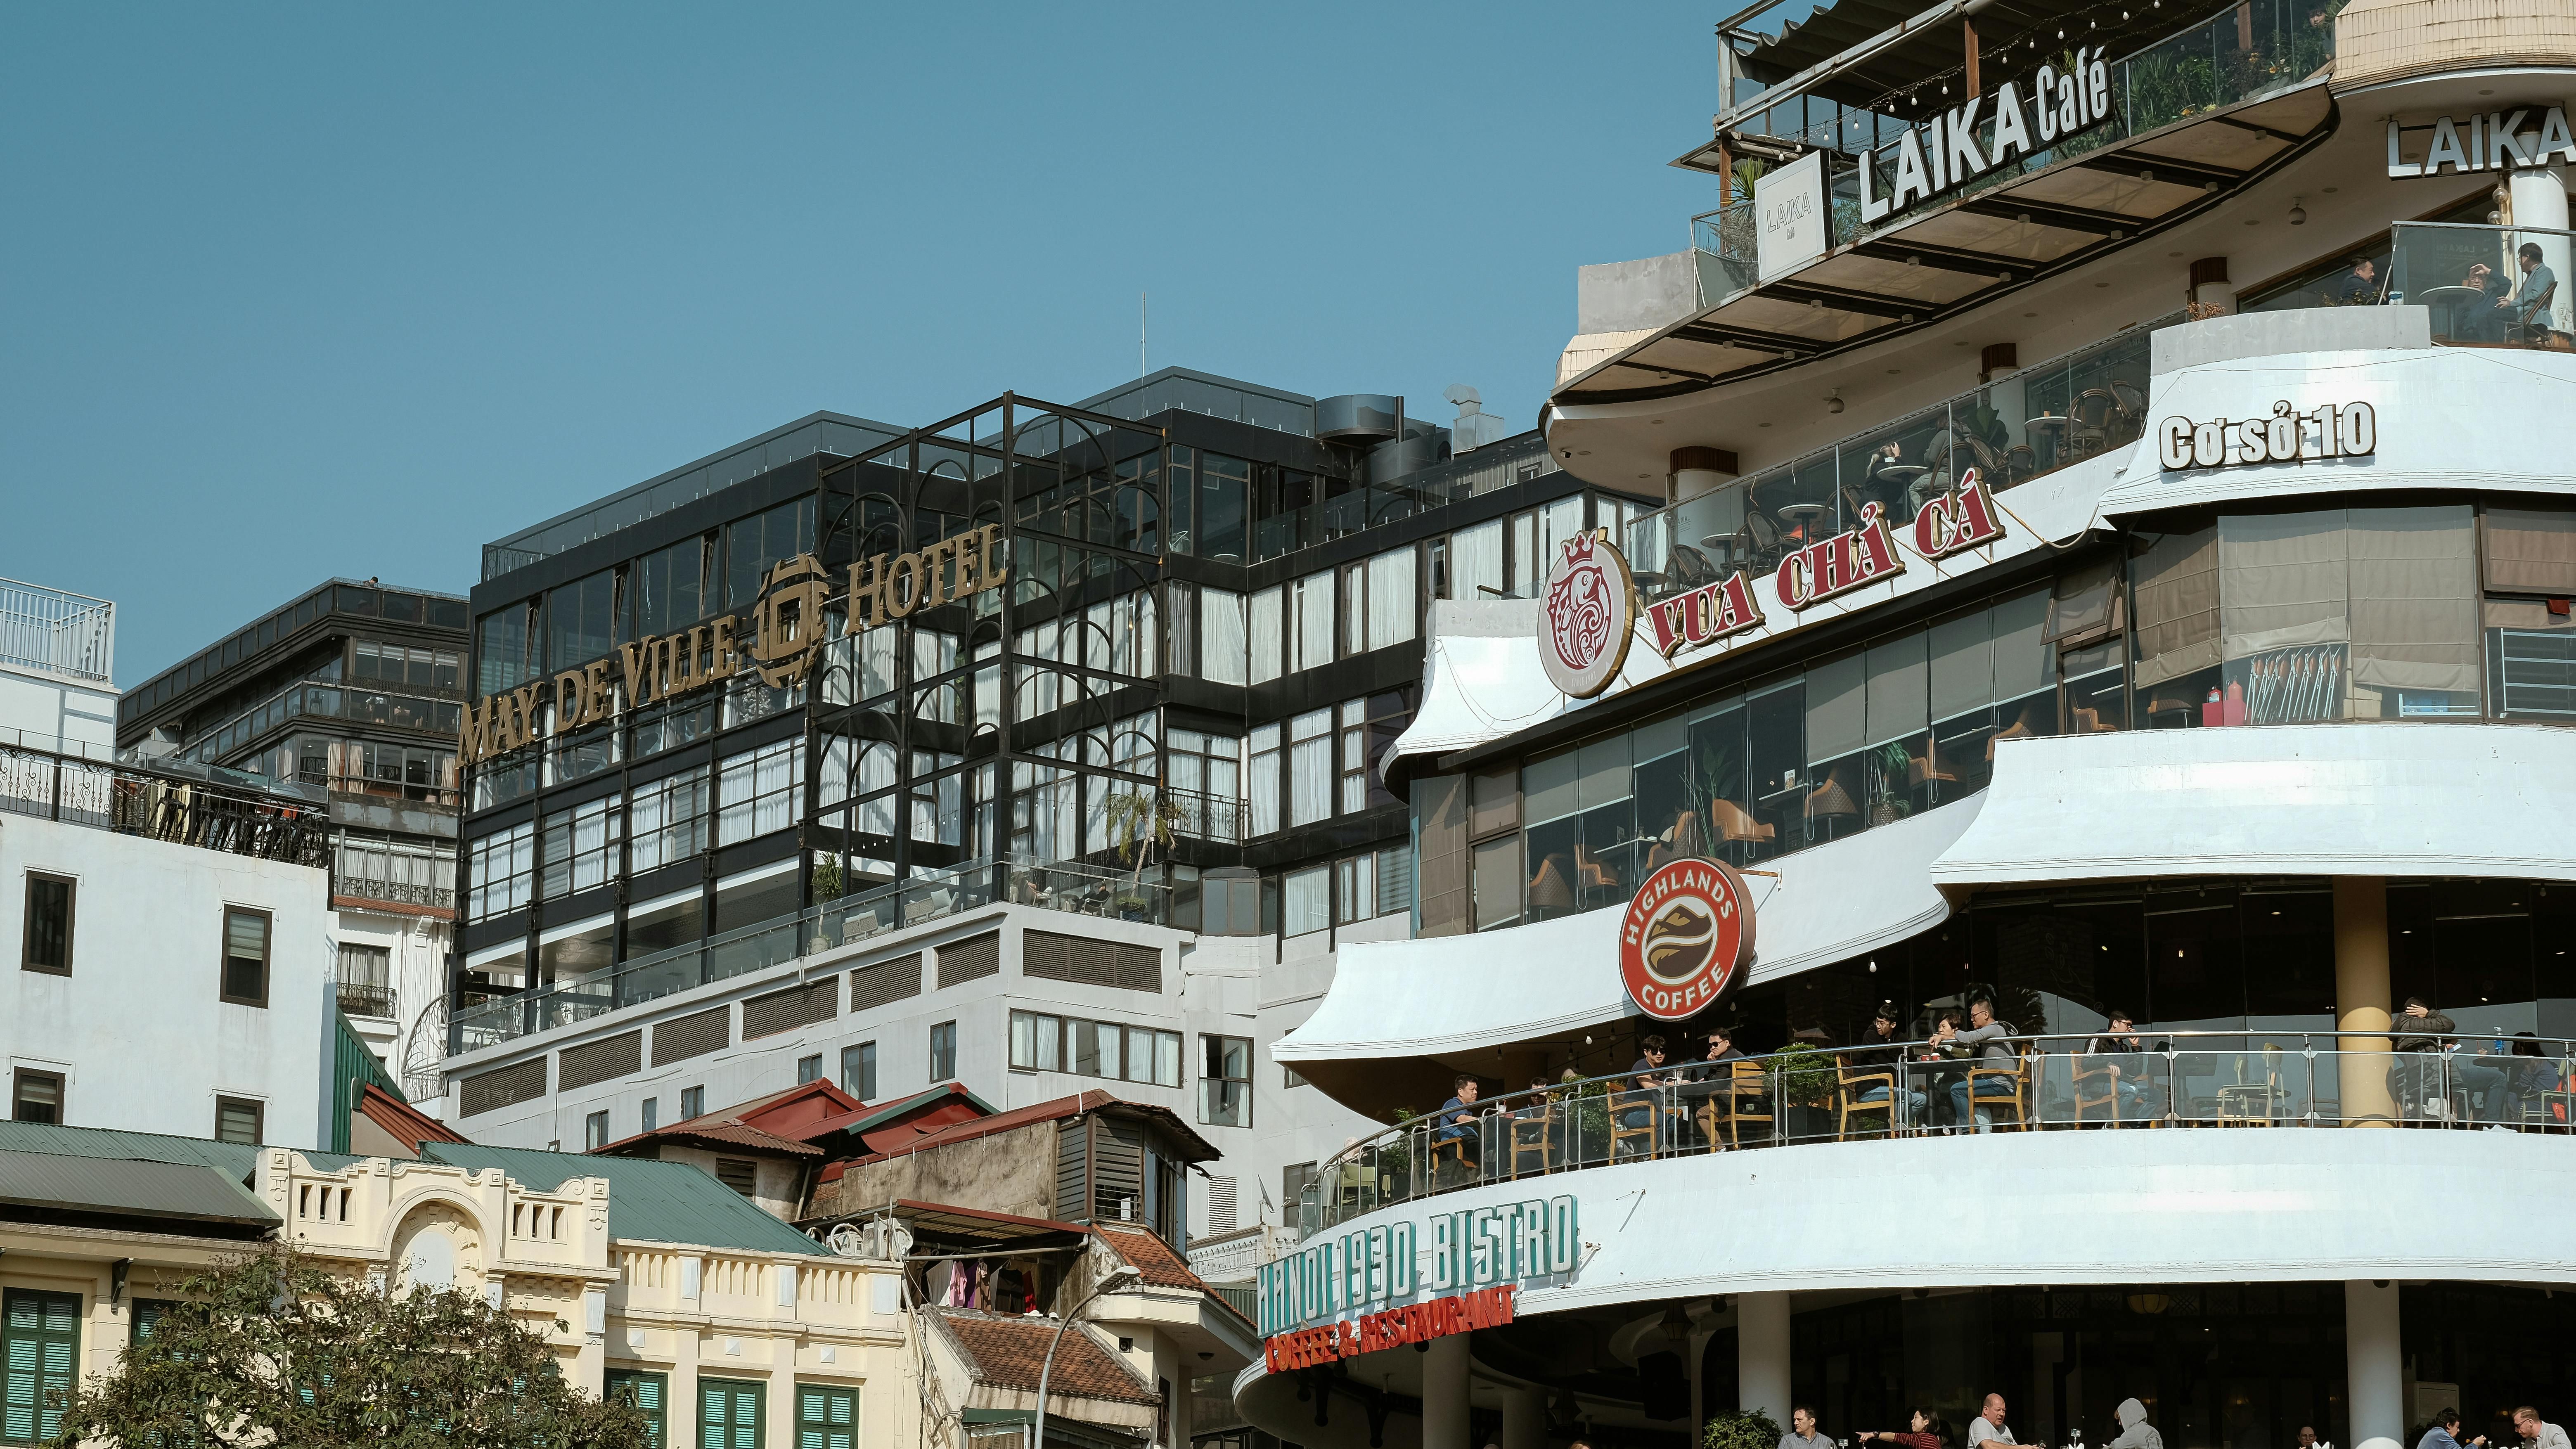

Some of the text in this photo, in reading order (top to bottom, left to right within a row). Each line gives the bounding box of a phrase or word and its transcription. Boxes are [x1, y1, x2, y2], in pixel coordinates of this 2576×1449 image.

[1858, 45, 2113, 225] LAIKA Café
[2387, 107, 2576, 180] LAIKA
[1766, 192, 1811, 233] LAIKA
[1786, 227, 1795, 240] Café
[2159, 400, 2376, 471] Cơ sở 10
[1646, 466, 2006, 658] VUA CHẢ CÁ
[455, 523, 1006, 769] MAY DE VILLE HOTEL
[1626, 869, 1733, 946] HIGHLANDS
[1641, 961, 1725, 1011] COFFEE
[1256, 1194, 1578, 1339] HANOI 1930 BISTRO
[1265, 1284, 1517, 1374] COFFEE & RESTAURANT
